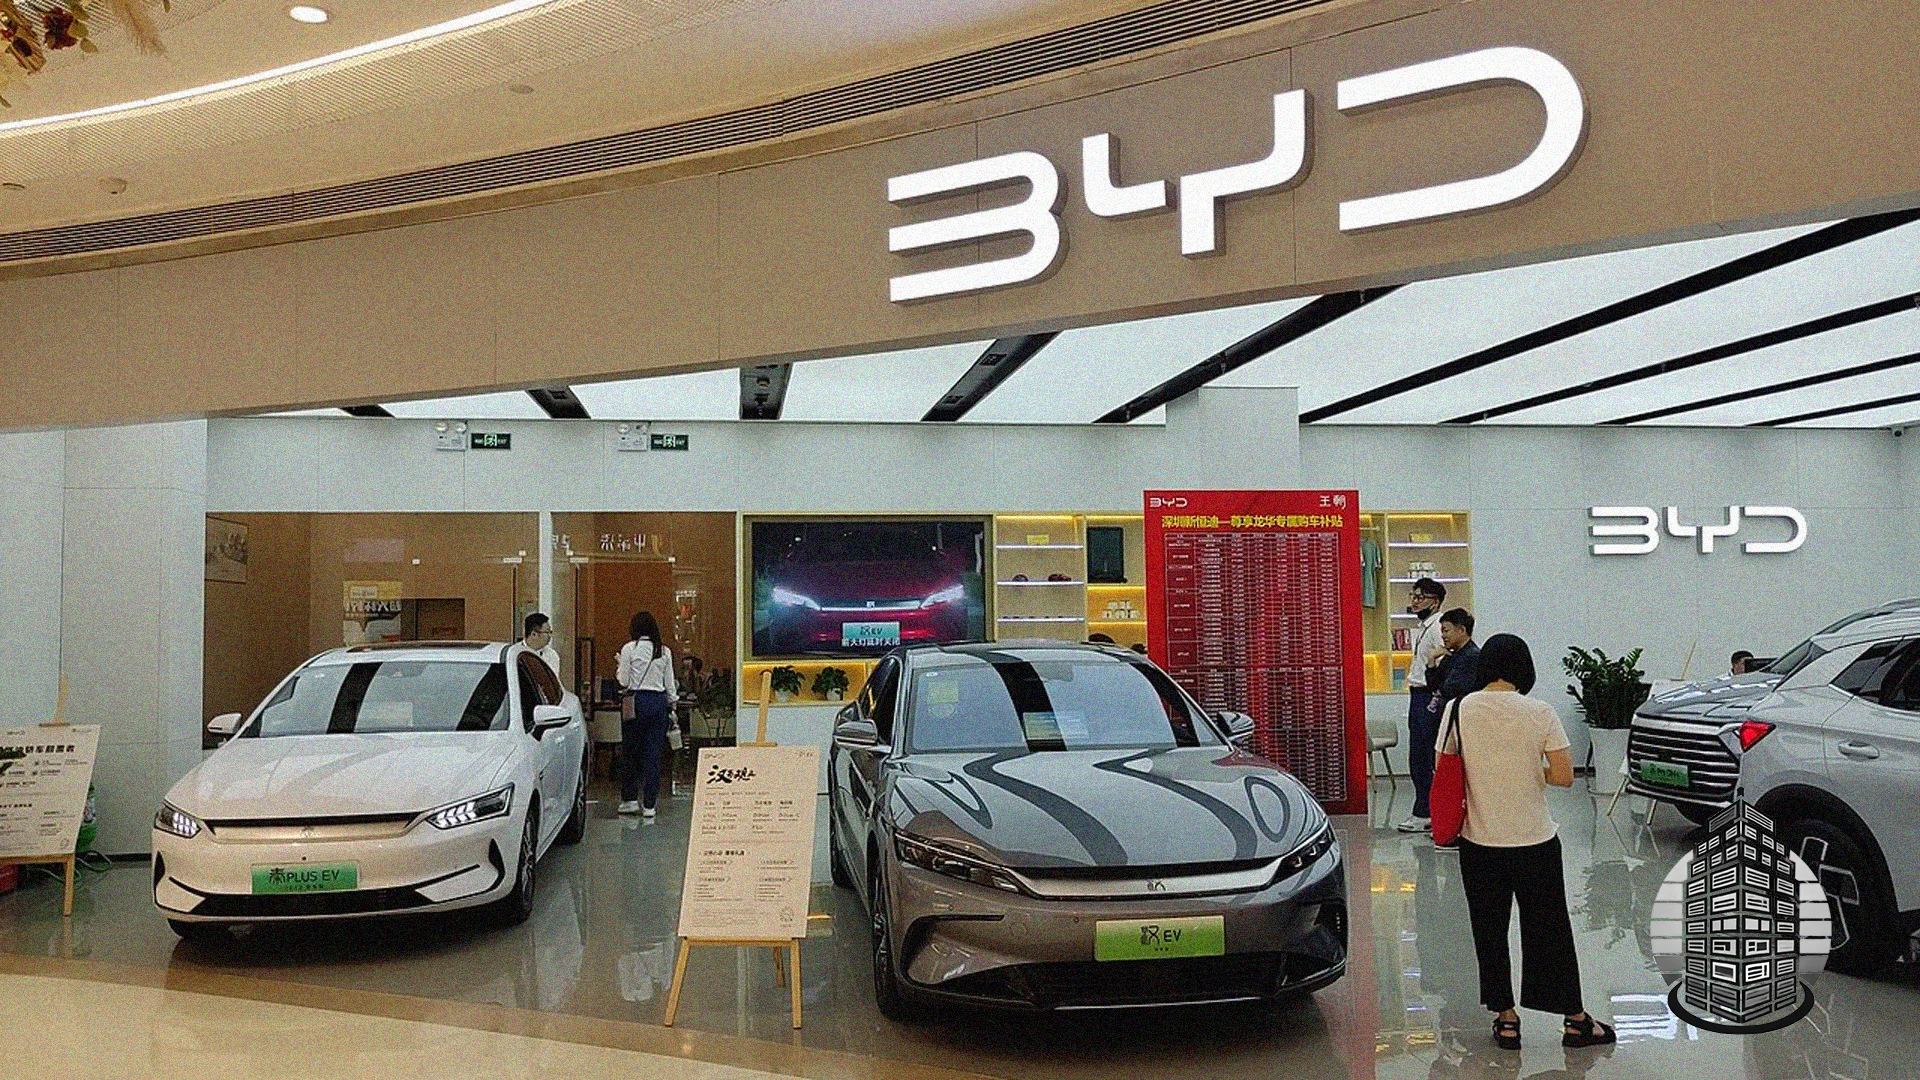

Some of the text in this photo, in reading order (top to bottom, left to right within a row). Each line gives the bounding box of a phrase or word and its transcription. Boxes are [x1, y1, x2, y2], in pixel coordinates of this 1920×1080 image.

[886, 45, 1586, 303] BYD
[1149, 497, 1188, 508] BYD
[1588, 505, 1808, 555] BYD
[321, 868, 340, 882] EV
